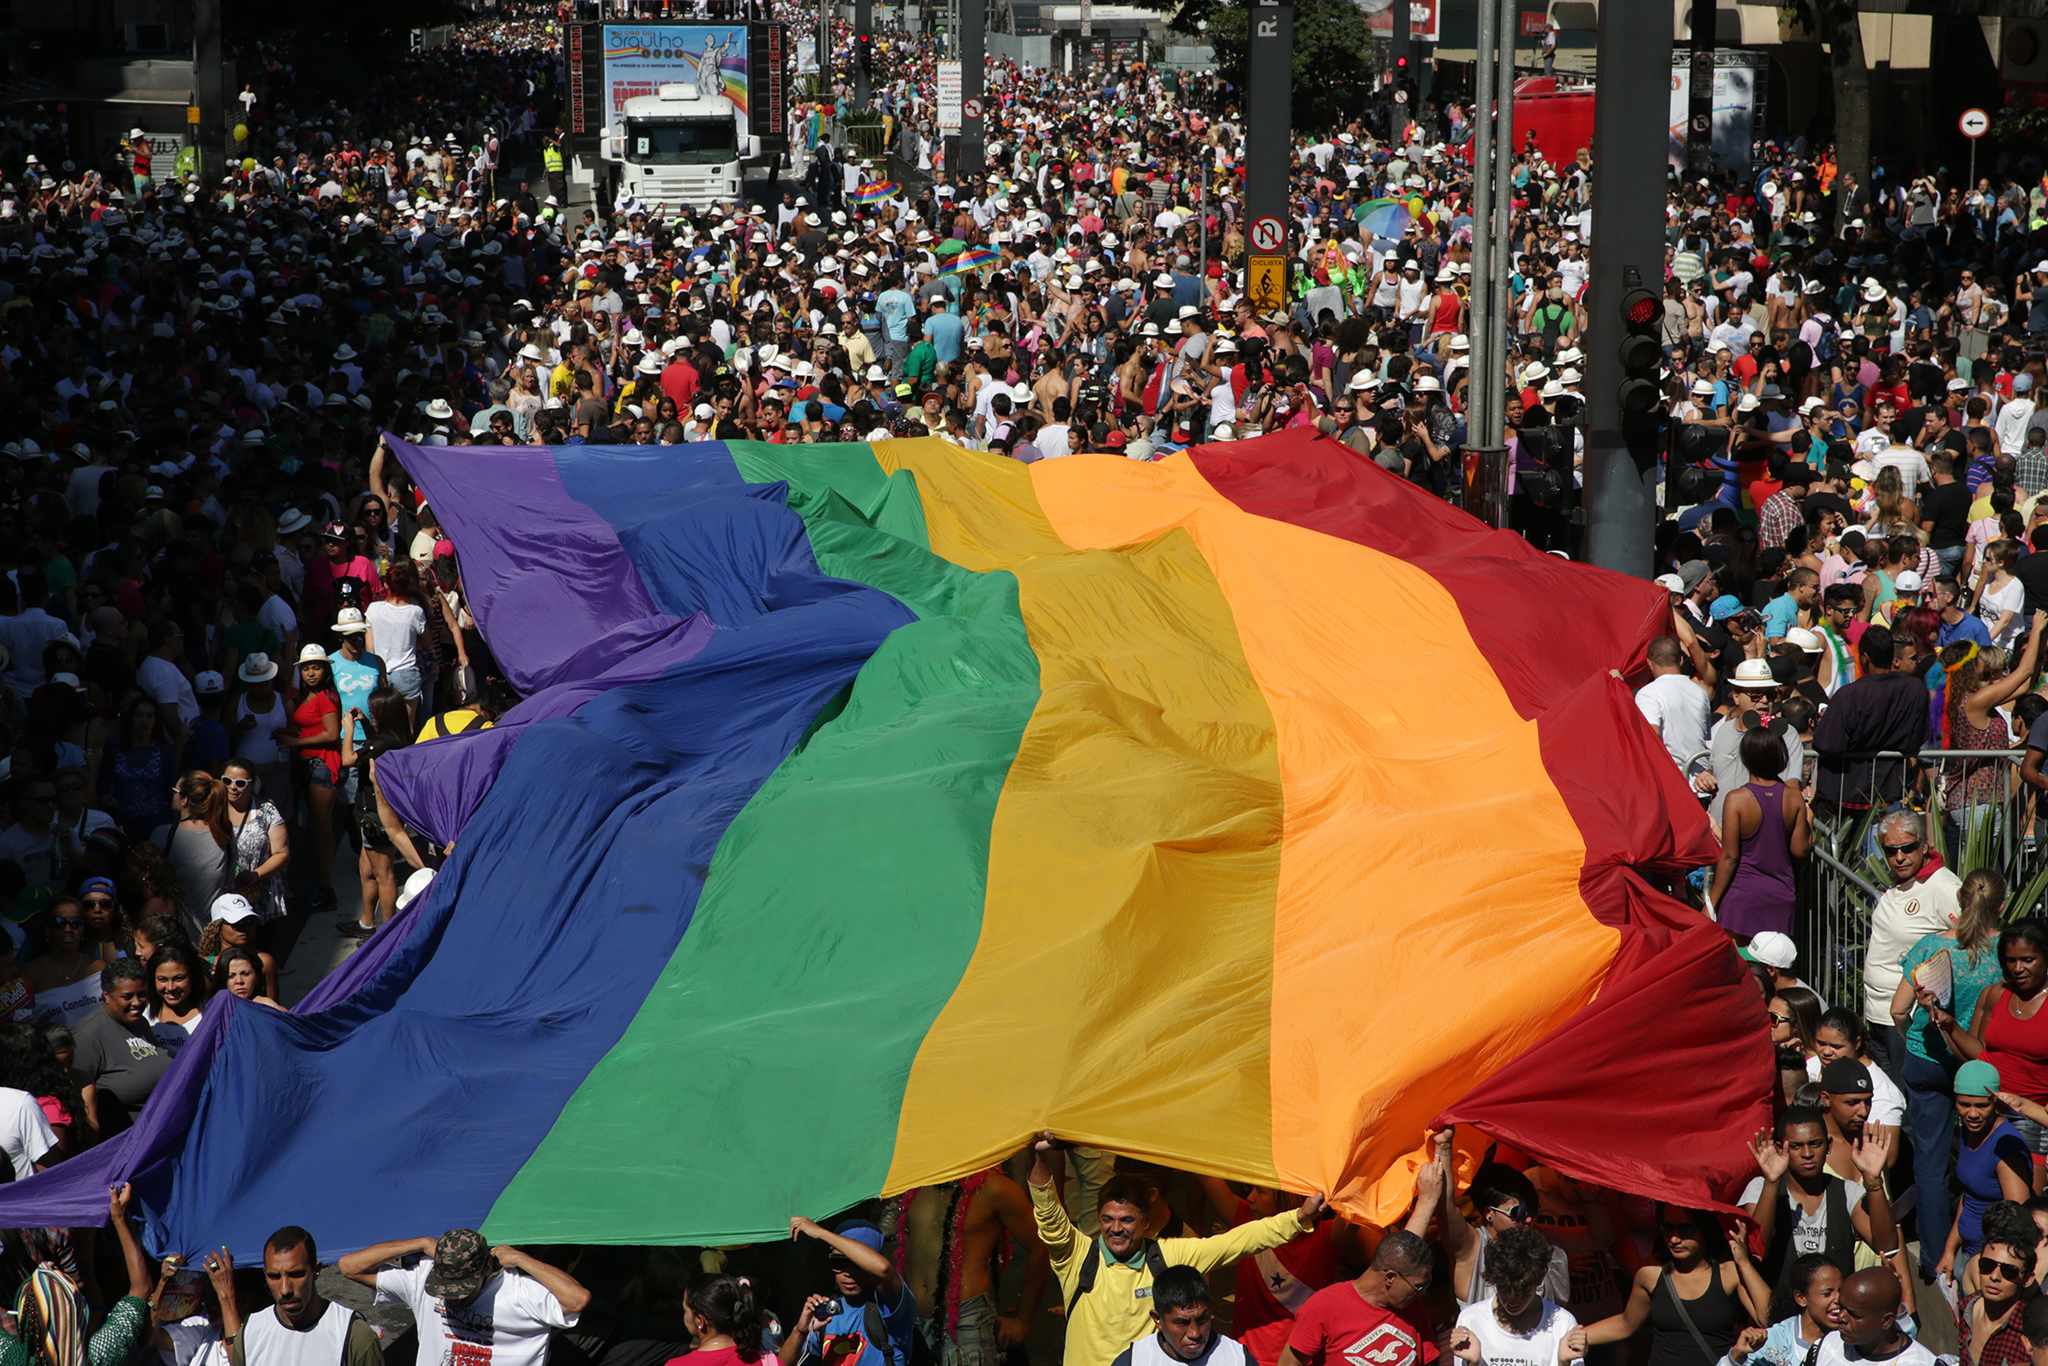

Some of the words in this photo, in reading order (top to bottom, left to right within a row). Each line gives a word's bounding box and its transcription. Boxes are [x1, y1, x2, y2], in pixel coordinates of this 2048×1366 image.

[611, 31, 684, 53] orgulho
[1, 982, 27, 1008] PCdoB
[47, 1004, 62, 1018] Sou
[62, 994, 98, 1012] Canalha
[451, 1342, 492, 1361] HOMO
[1353, 1329, 1383, 1353] HOLLISTER
